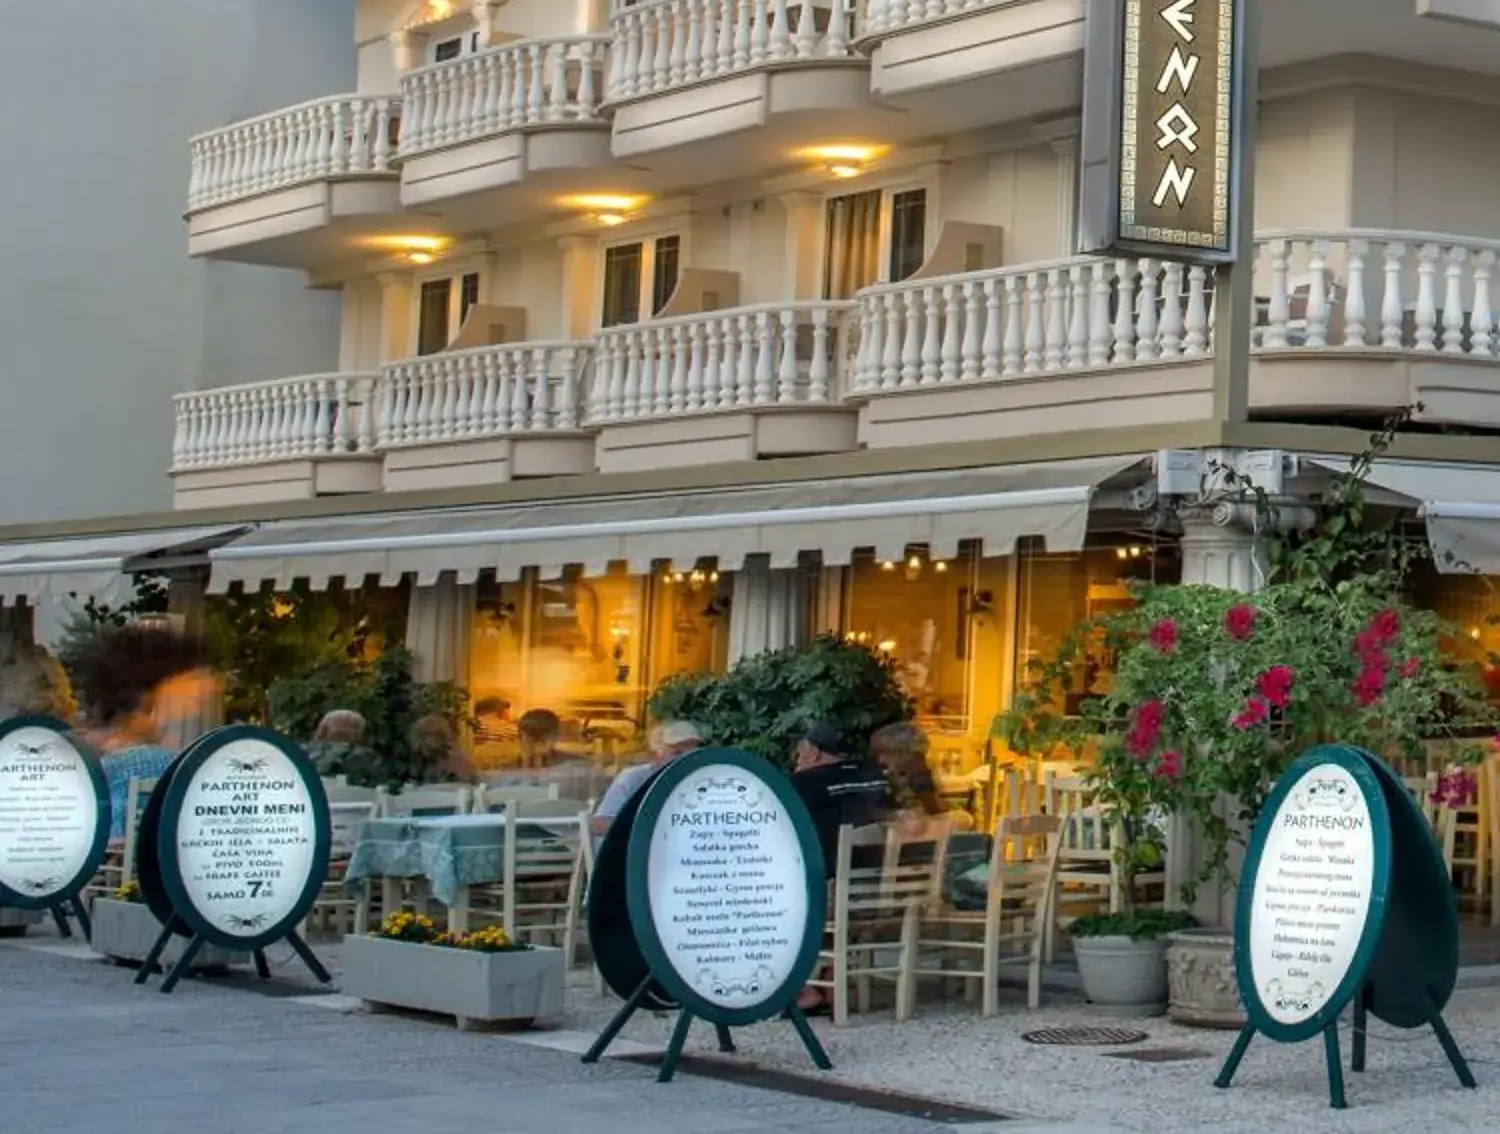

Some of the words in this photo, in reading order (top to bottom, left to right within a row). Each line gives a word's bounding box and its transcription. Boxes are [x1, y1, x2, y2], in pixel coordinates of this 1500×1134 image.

[201, 780, 295, 792] PARTHENON
[232, 793, 260, 802] ART
[194, 805, 259, 816] DNEVNI
[264, 803, 306, 815] MENI
[671, 810, 778, 827] PARTHENON
[1283, 813, 1365, 830] PARTHENON
[215, 860, 244, 869] PIVO
[206, 889, 246, 900] SAMO
[246, 880, 263, 899] 7
